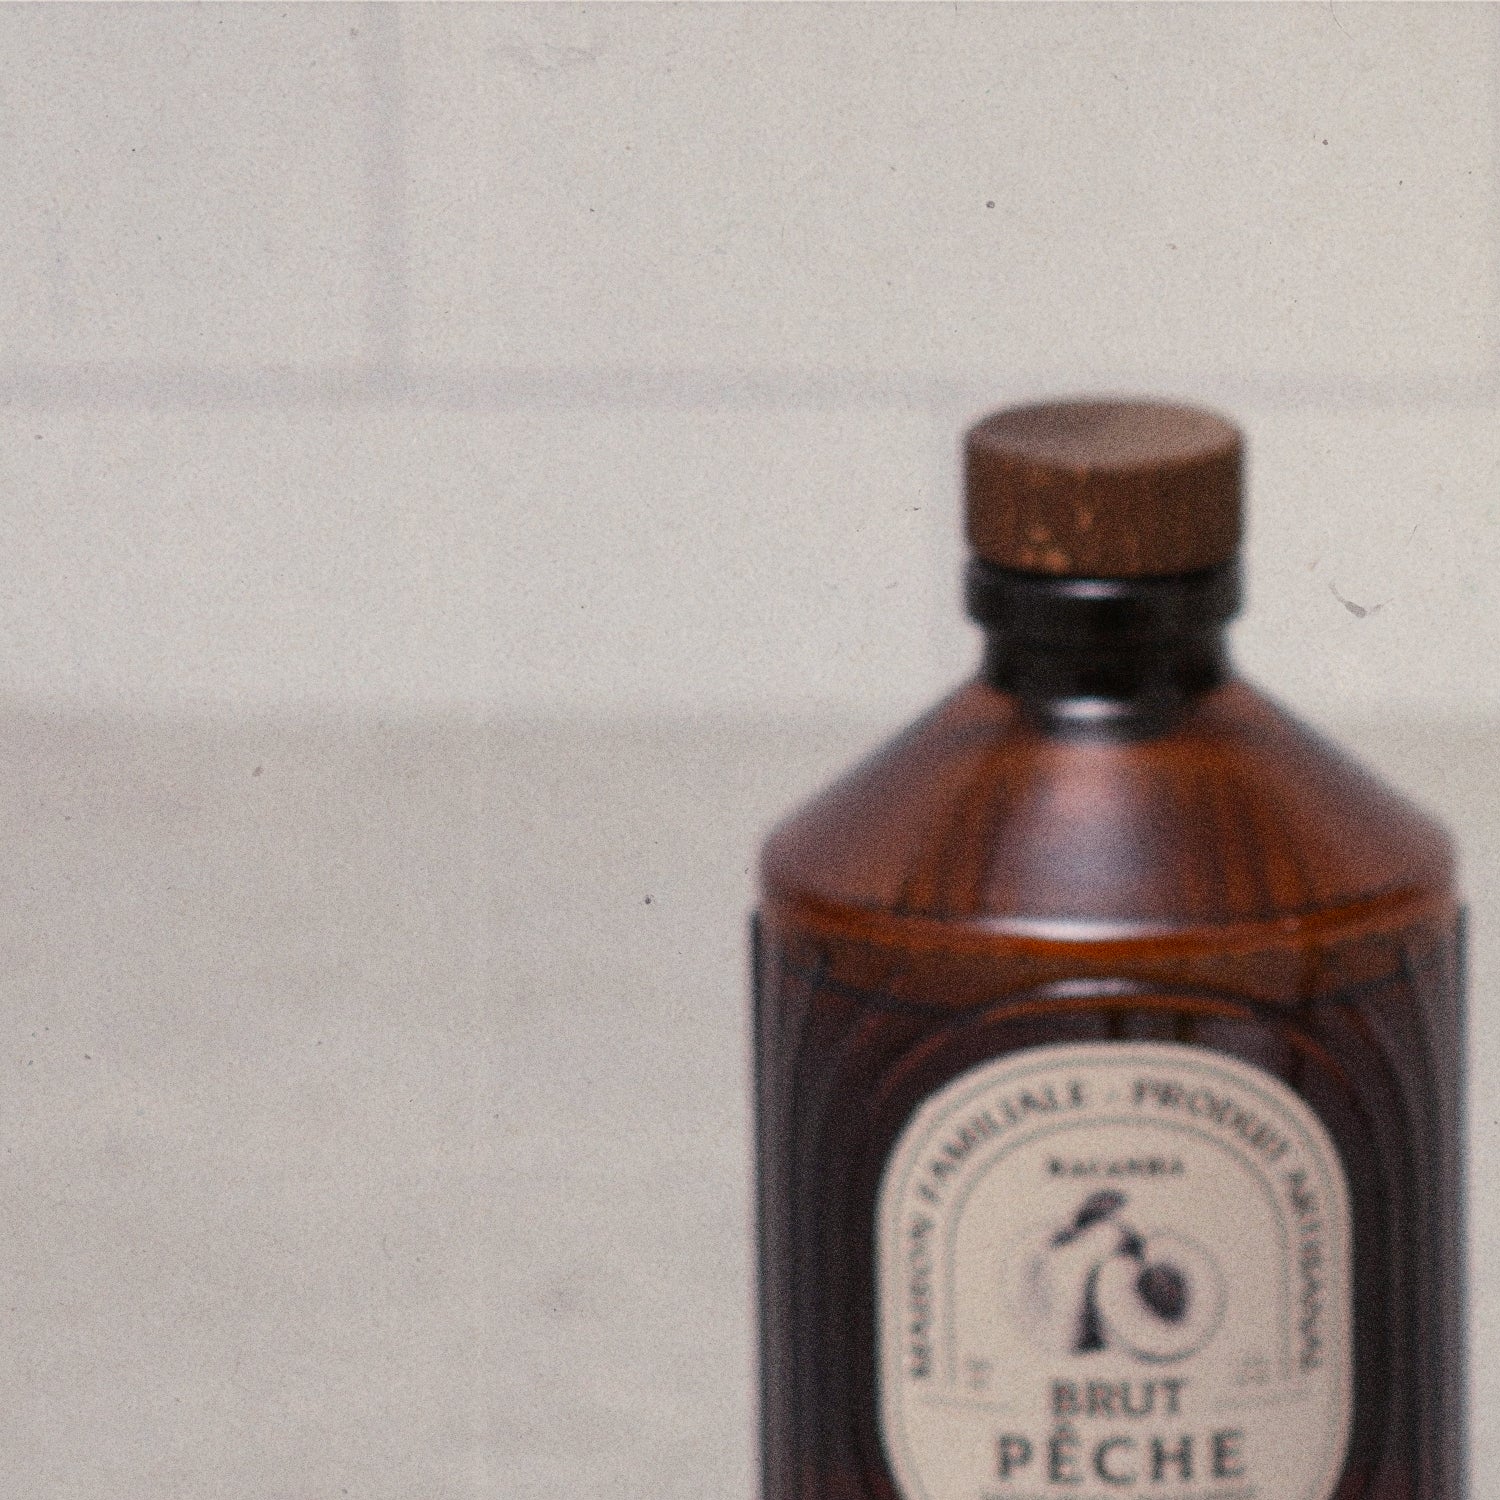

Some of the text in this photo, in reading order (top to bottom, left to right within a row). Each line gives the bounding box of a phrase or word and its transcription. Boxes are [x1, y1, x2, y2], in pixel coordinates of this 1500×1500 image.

[918, 1079, 1084, 1203] FAMILIALE
[1132, 1078, 1289, 1160] PRODUIT
[1052, 1378, 1187, 1416] BRUT
[998, 1422, 1247, 1484] PÊCHE
